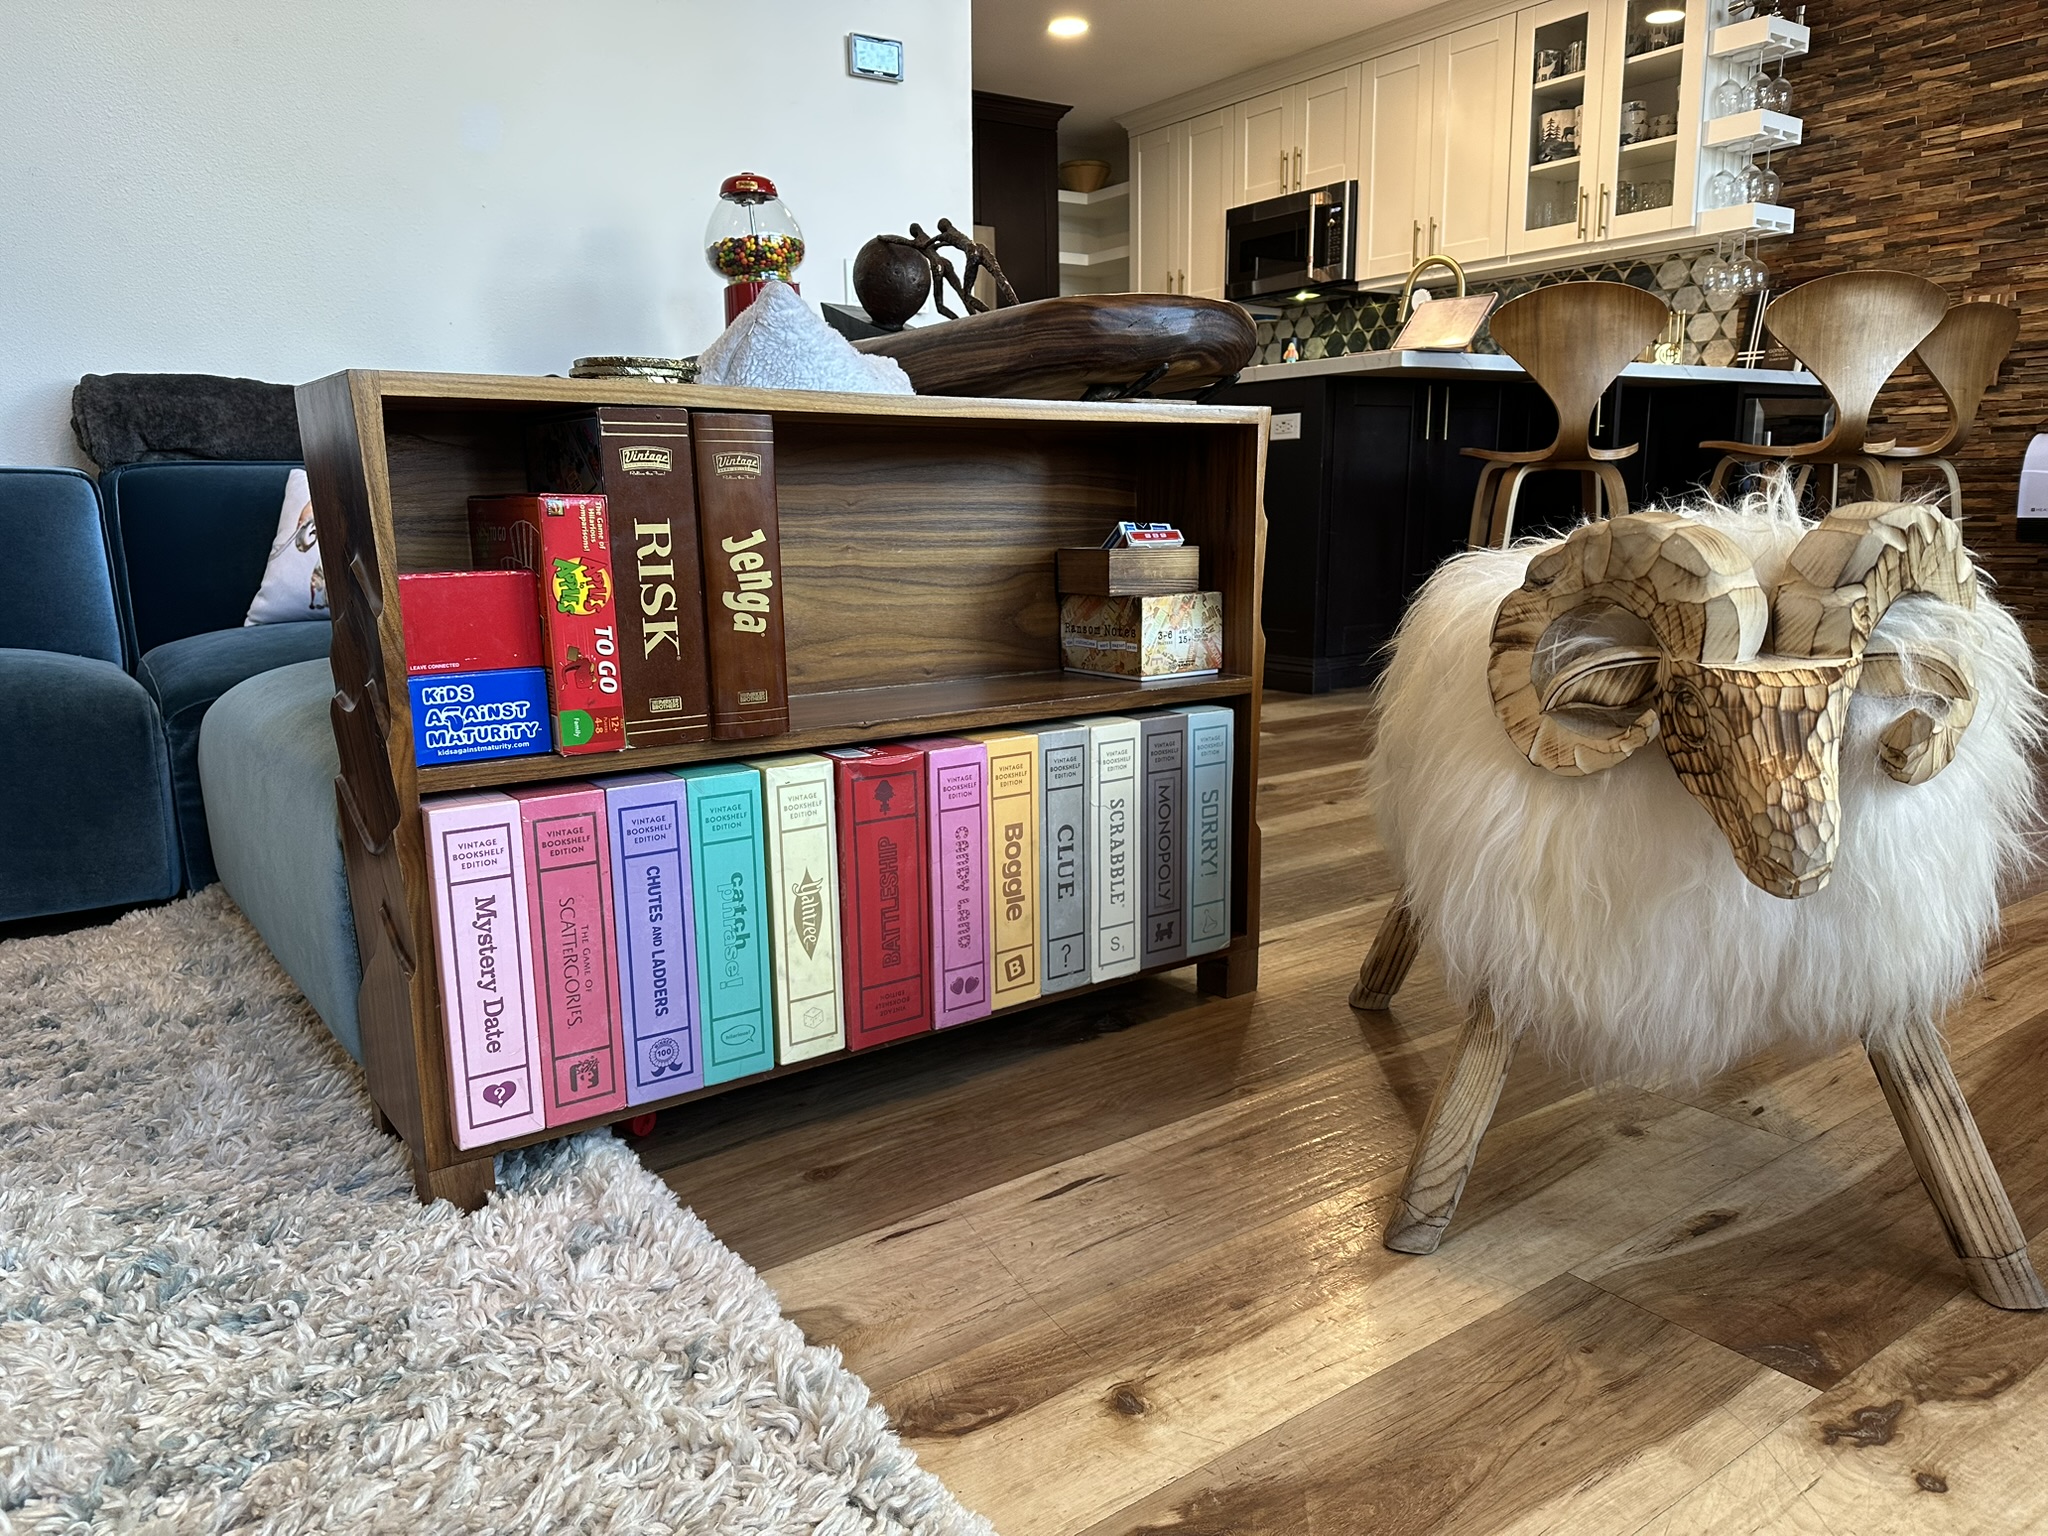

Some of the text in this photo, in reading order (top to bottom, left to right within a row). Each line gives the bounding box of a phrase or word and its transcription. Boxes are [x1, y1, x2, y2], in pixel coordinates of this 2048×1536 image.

[624, 449, 669, 464] Vintage
[718, 456, 758, 468] Vintage
[588, 508, 596, 543] Hilarious
[596, 517, 604, 541] Game
[599, 541, 606, 550] of
[552, 557, 581, 615] APPLES
[579, 556, 608, 614] APPLES
[721, 528, 773, 634] Jenga
[634, 518, 681, 660] RISK
[1065, 623, 1137, 638] Ransom Notes
[594, 625, 618, 694] TO GO
[410, 662, 460, 671] LEAVE CONNECTED
[573, 718, 581, 737] Family
[594, 717, 603, 734] 4-8
[610, 716, 619, 733] 12+
[437, 742, 530, 756] kidsagainstmaturity.com
[1106, 749, 1128, 757] VINTAGE
[1150, 748, 1179, 756] BOOKSHELF
[1053, 756, 1077, 764] VINTAGE
[1103, 755, 1131, 765] BOOKSHELF
[999, 763, 1023, 772] VINTAGE
[1050, 762, 1081, 772] BOOKSHELF
[1107, 764, 1127, 772] EDITION
[947, 774, 972, 783] VINTAGE
[995, 771, 1028, 780] BOOKSHELF
[1055, 771, 1077, 779] EDITION
[943, 781, 977, 793] BOOKSHELF
[1000, 779, 1023, 788] EDITION
[788, 792, 817, 801] VINTAGE
[948, 791, 972, 800] EDITION
[709, 803, 742, 813] VINTAGE
[783, 800, 822, 812] BOOKSHELF
[631, 815, 666, 825] VINTAGE
[705, 811, 748, 824] BOOKSHELF
[790, 809, 818, 820] EDITION
[547, 826, 584, 837] VINTAGE
[626, 823, 673, 836] BOOKSHELF
[711, 821, 742, 832] EDITION
[1201, 789, 1219, 877] SORRY!
[458, 838, 498, 850] VINTAGE
[542, 835, 591, 848] BOOKSHELF
[634, 833, 666, 844] EDITION
[1158, 785, 1171, 901] MONOPOLY
[452, 847, 505, 861] BOOKSHELF
[550, 846, 584, 857] EDITION
[1110, 798, 1125, 905] SCRABBLE
[461, 858, 498, 869] EDITION
[1057, 824, 1075, 899] CLUE
[1002, 822, 1026, 921] Boggle
[878, 836, 900, 968] BATTLESHIP
[730, 871, 750, 951] catch
[791, 877, 824, 944] Yahtzee
[646, 865, 669, 1017] CHUTES AND LADDERS
[717, 882, 744, 990] phrase!
[559, 897, 583, 1027] SCATTERGORIES
[581, 924, 593, 993] THE GAME OF
[472, 895, 504, 1053] Mystery Date
[1009, 959, 1021, 978] B
[725, 1029, 751, 1040] hilarious!
[657, 1048, 672, 1057] 100
